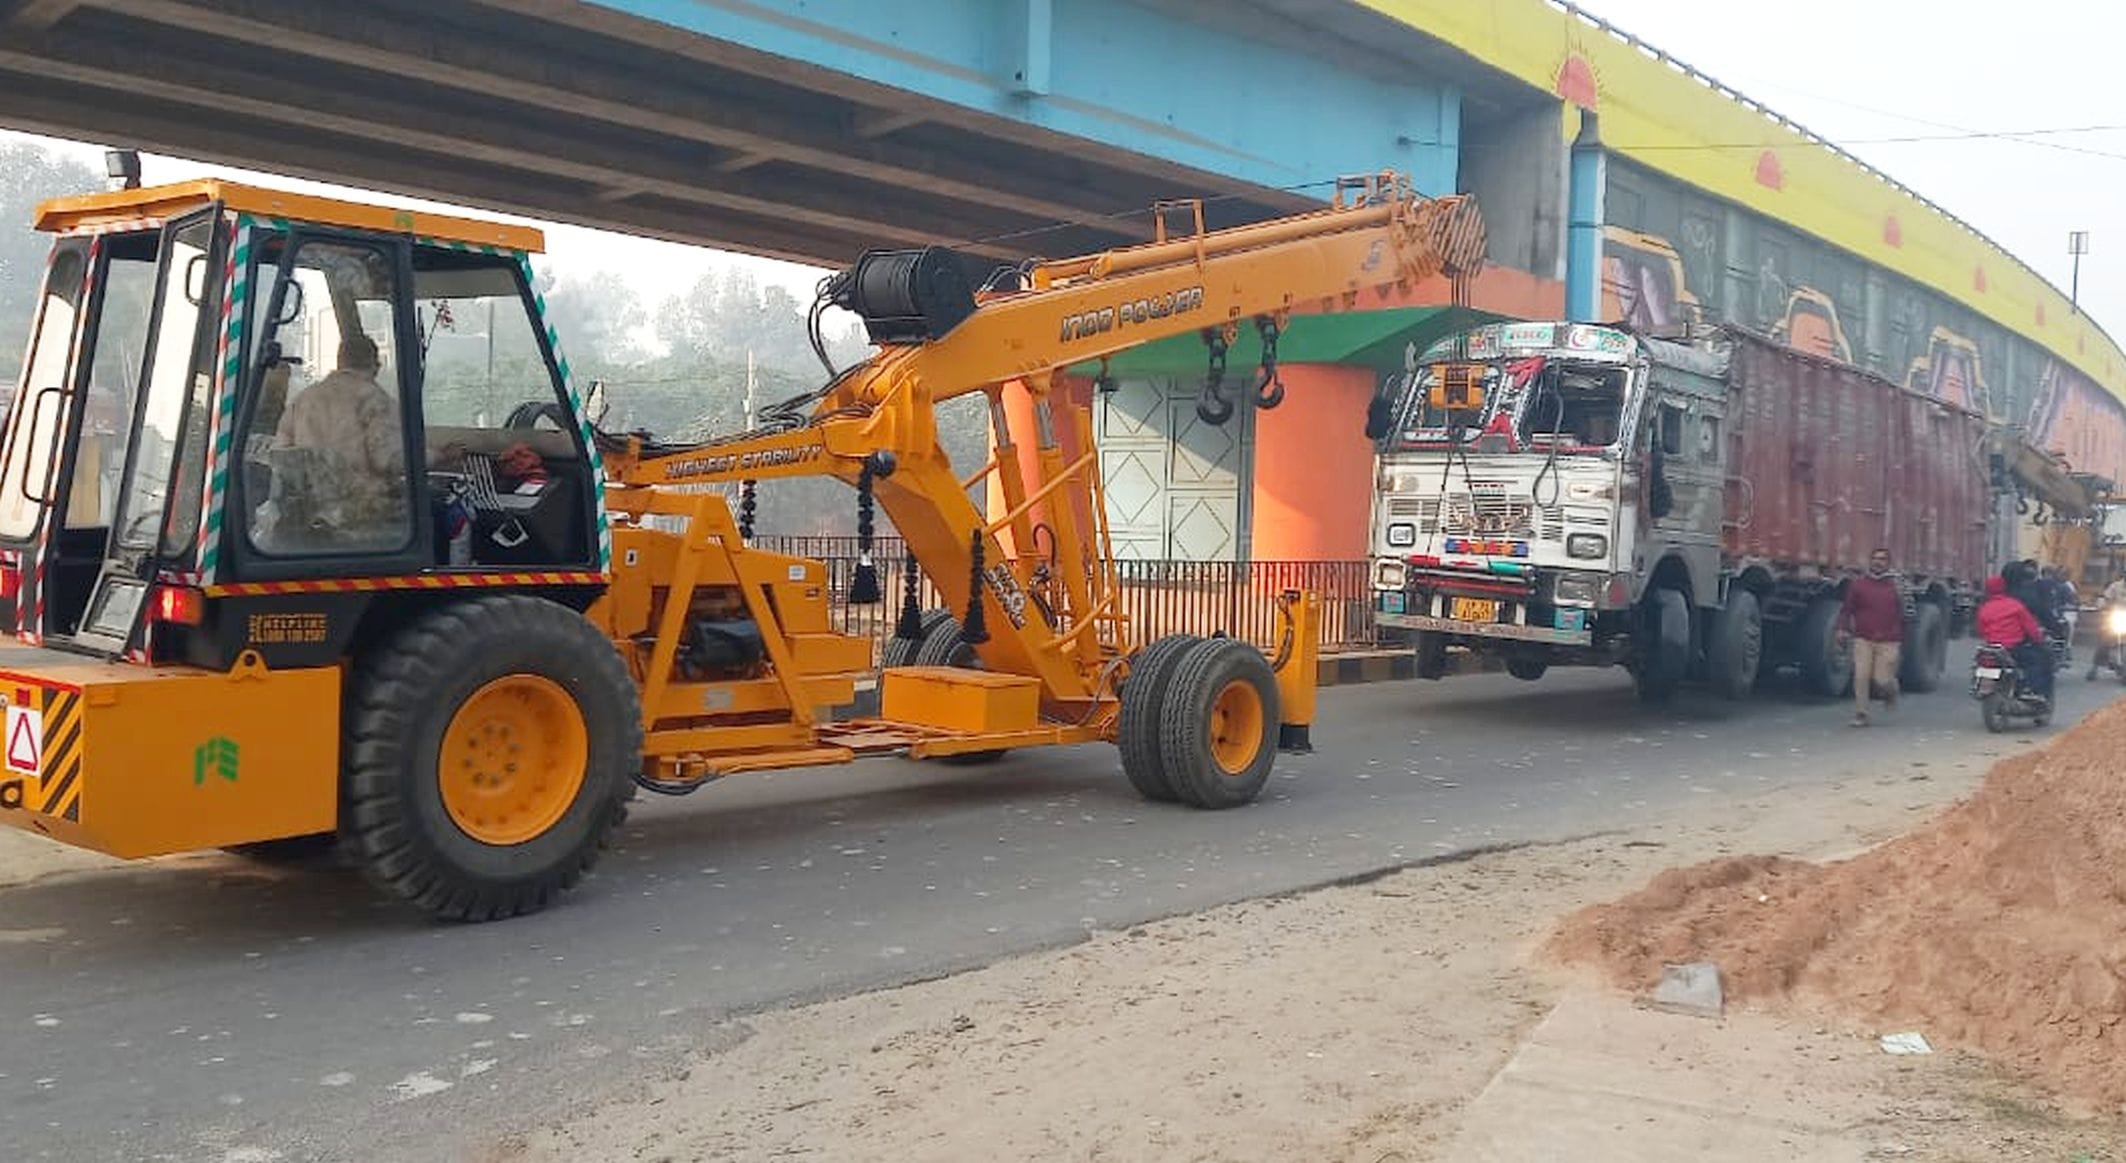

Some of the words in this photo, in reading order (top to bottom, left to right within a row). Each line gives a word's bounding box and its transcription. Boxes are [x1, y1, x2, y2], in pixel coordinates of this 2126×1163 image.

[1118, 286, 1204, 328] POWER
[665, 455, 737, 480] HIGHEST
[740, 443, 824, 470] STABILITY
